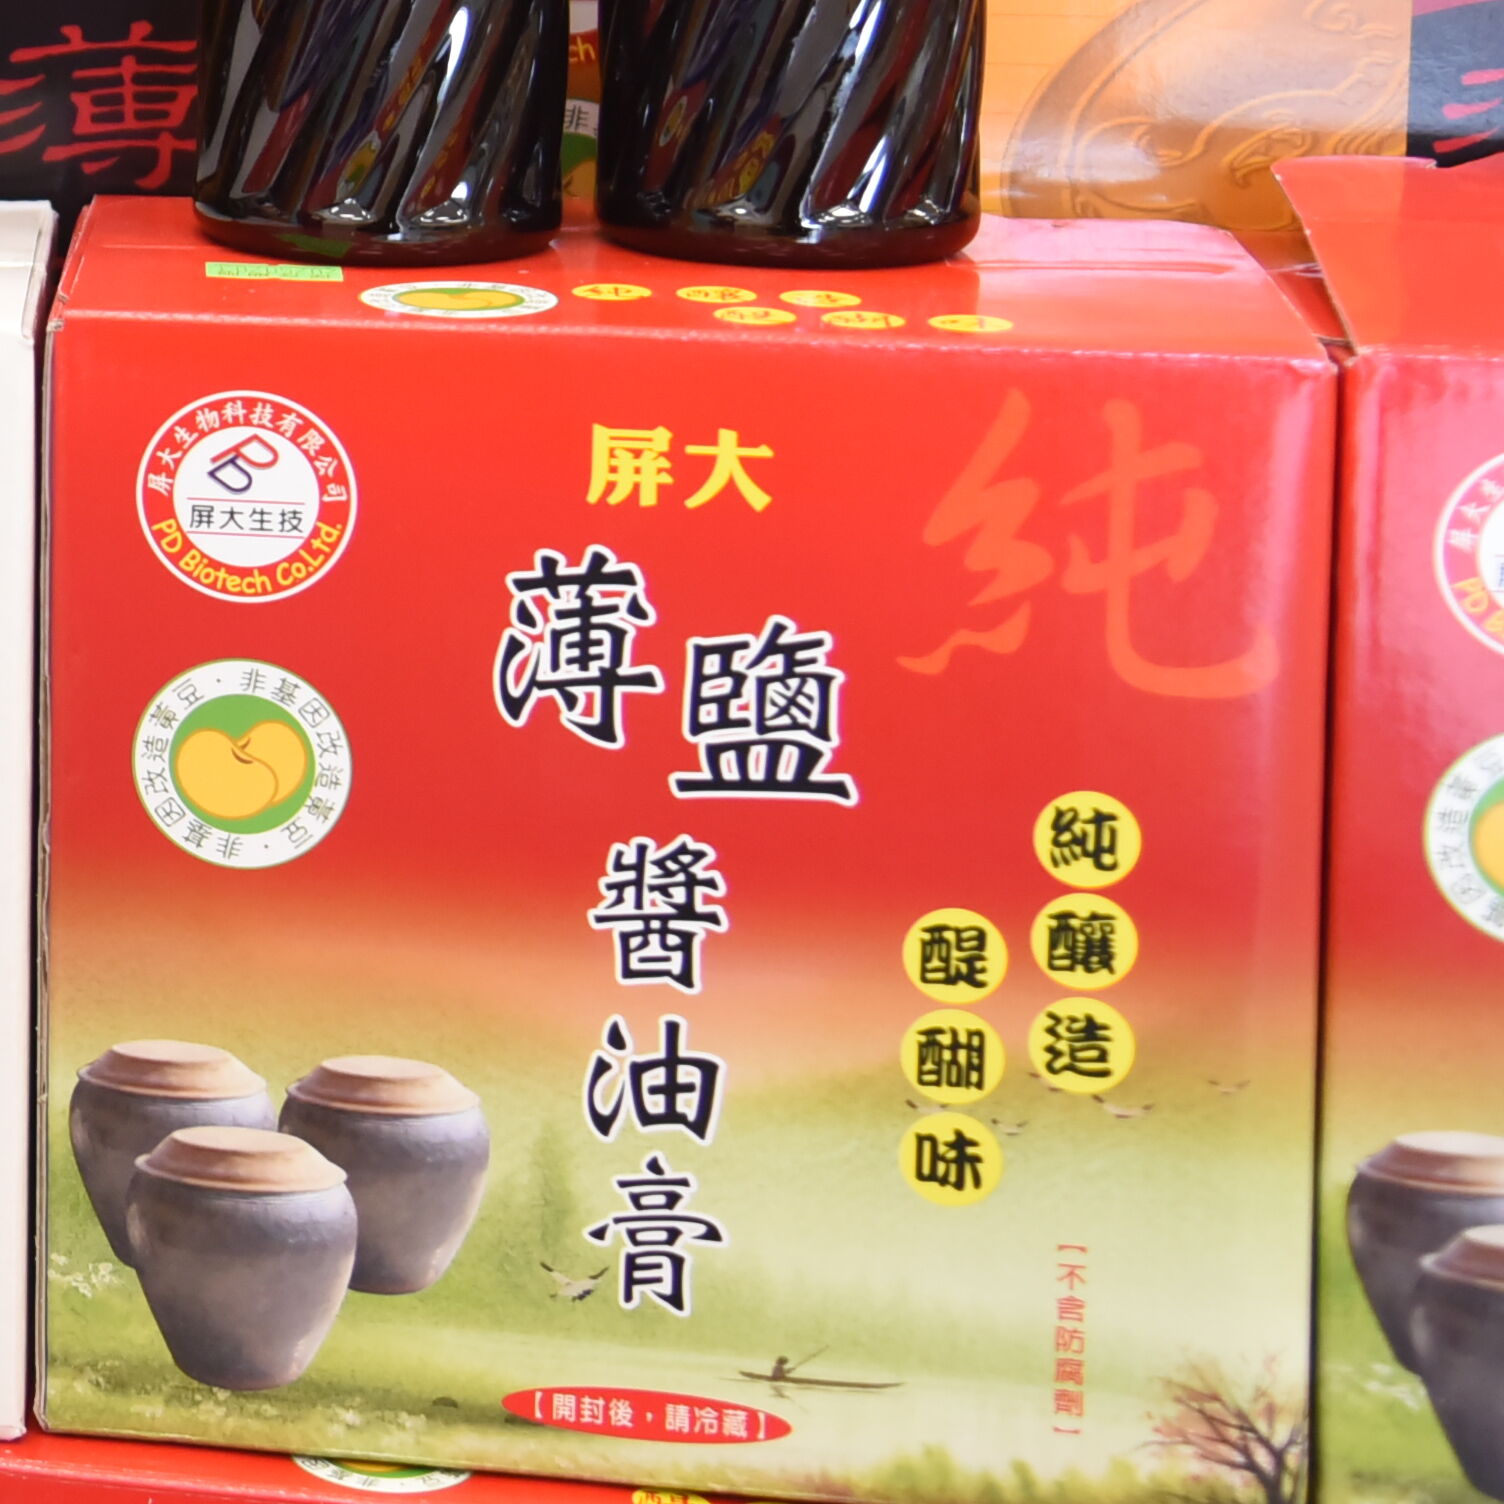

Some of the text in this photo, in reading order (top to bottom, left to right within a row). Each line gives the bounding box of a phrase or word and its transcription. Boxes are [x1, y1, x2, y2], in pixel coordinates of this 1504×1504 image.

[586, 425, 775, 512] 屏大
[151, 518, 183, 553] PD
[179, 552, 273, 595] Biotech
[189, 504, 303, 534] 屏大生技
